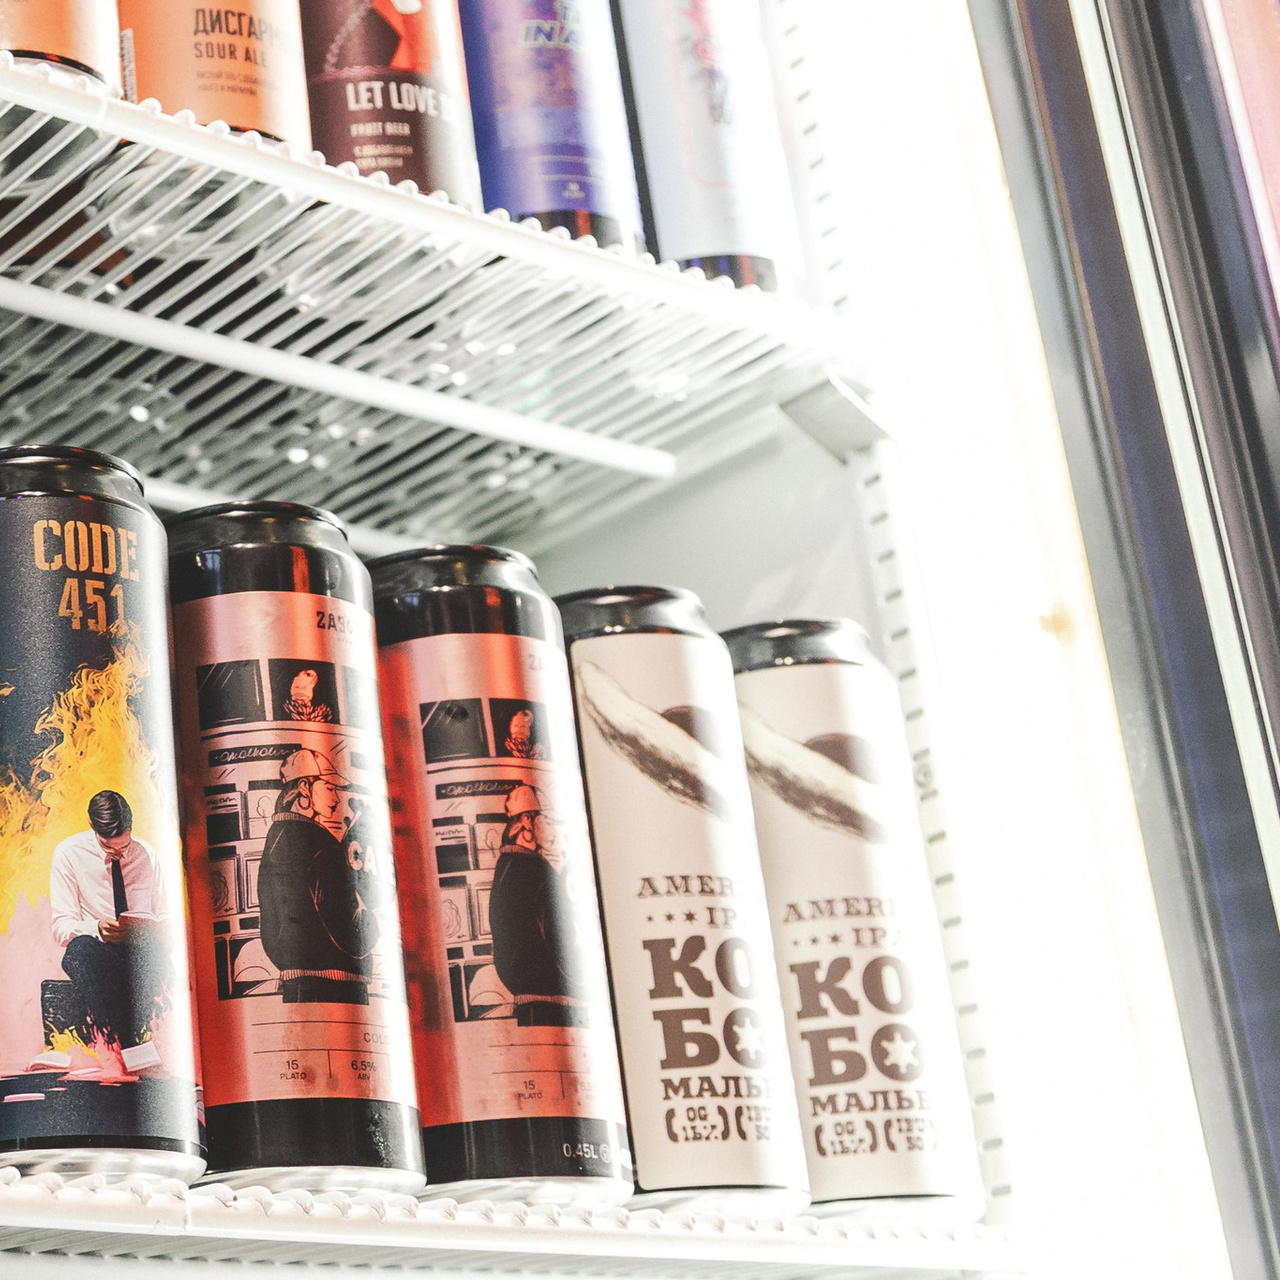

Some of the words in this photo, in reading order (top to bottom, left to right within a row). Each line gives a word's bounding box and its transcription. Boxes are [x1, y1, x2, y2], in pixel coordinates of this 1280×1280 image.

[195, 42, 237, 60] SOUR
[244, 47, 266, 66] ALE
[346, 81, 384, 111] LET
[389, 81, 438, 117] LOVE
[33, 519, 140, 581] CODE
[58, 577, 125, 631] 451
[642, 935, 758, 1000] КО
[790, 956, 916, 1020] КО
[652, 1007, 767, 1070] БО
[800, 1023, 925, 1087] БО
[280, 1072, 306, 1080] PLATO
[286, 1060, 299, 1070] 15
[351, 1059, 377, 1071] 6.5%
[523, 1080, 535, 1090] 15
[686, 1106, 708, 1122] OG
[563, 1143, 598, 1159] 0.45L
